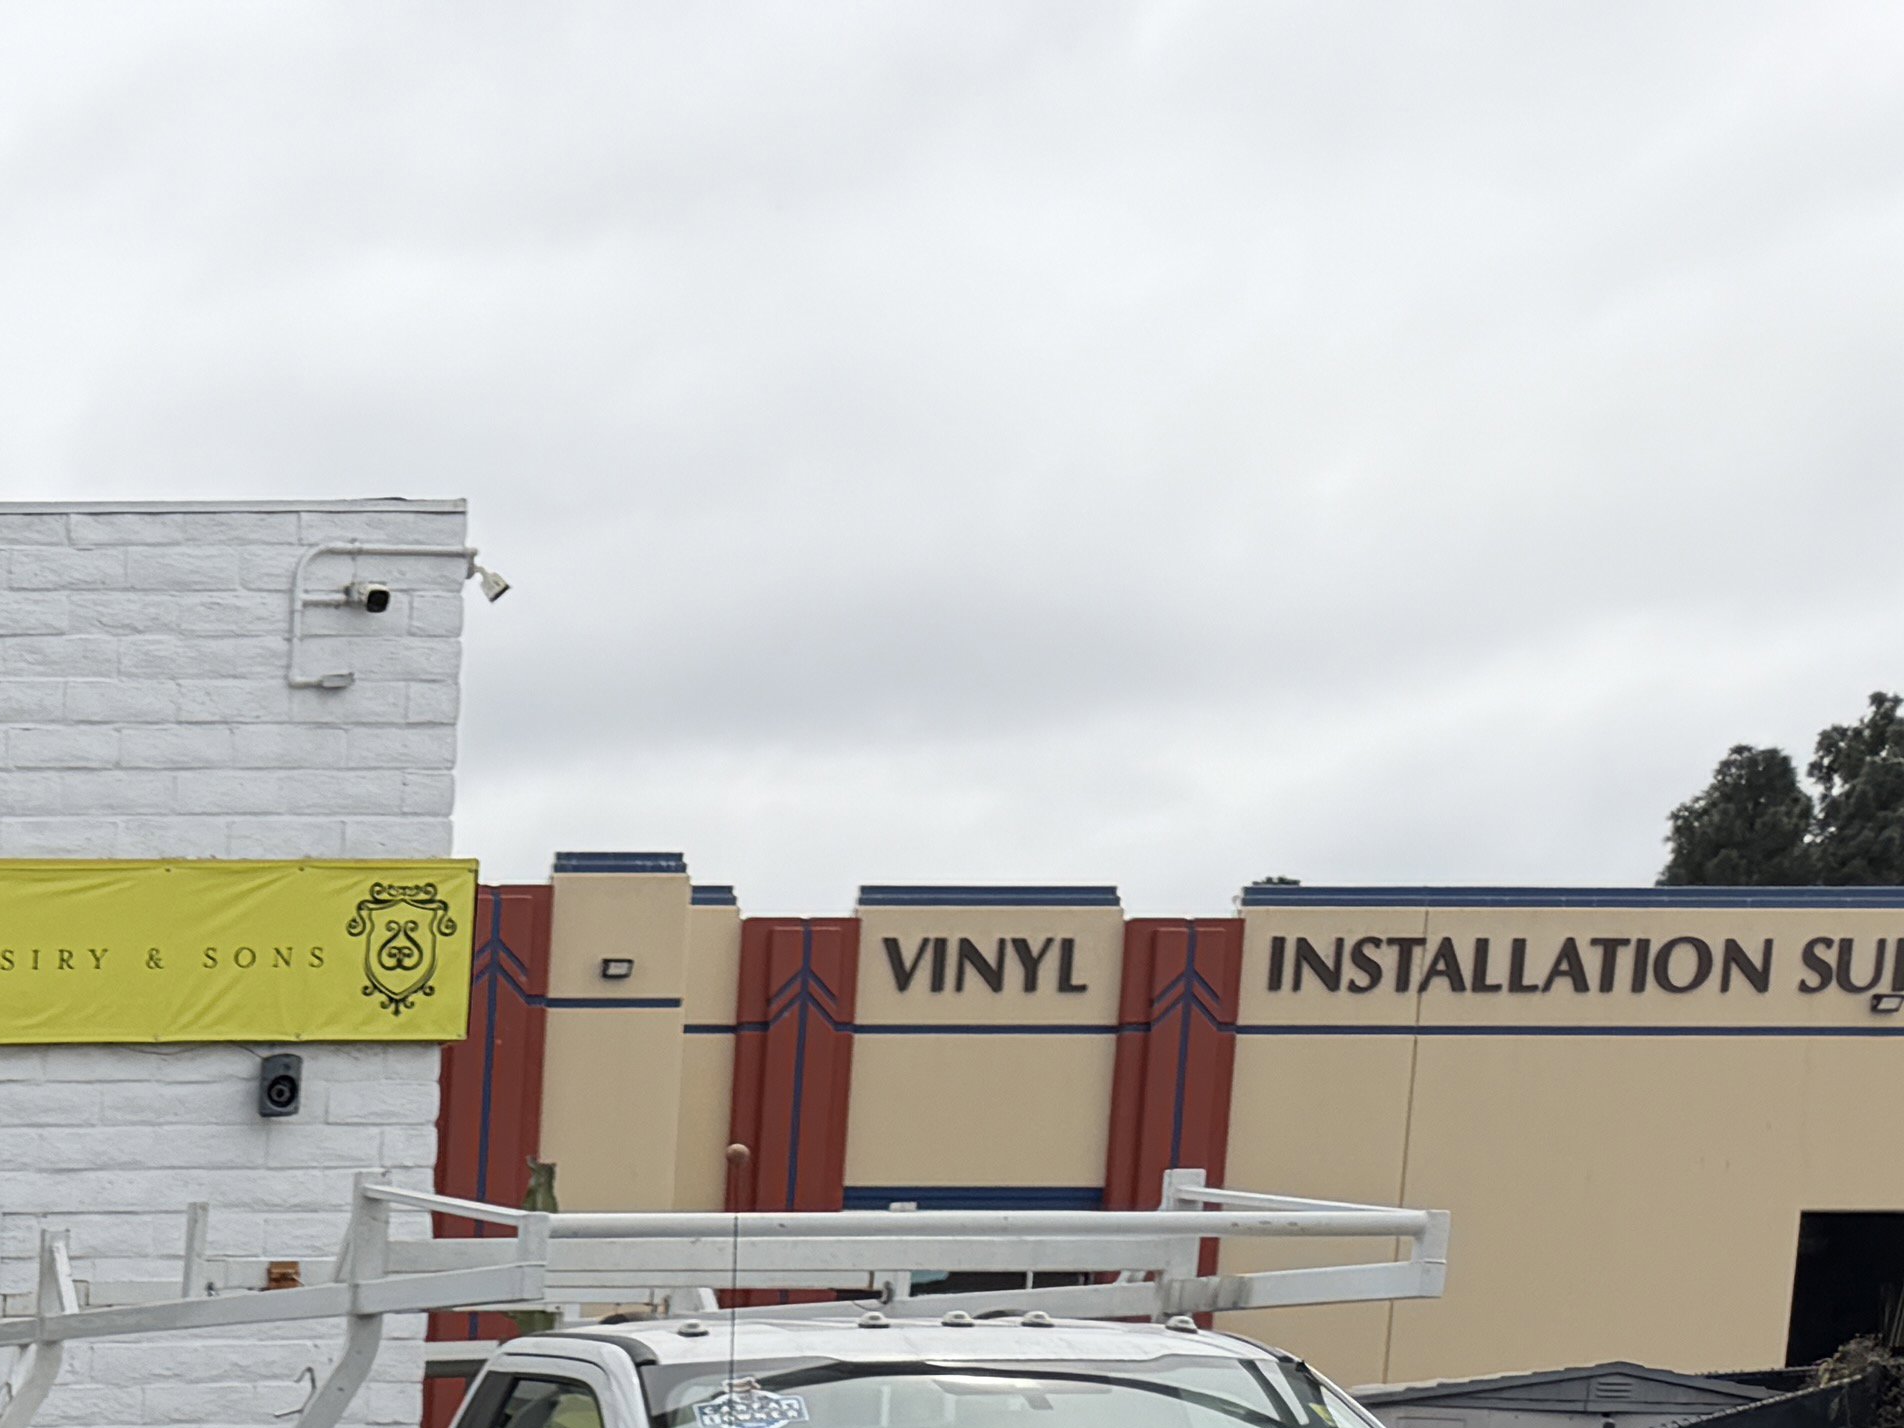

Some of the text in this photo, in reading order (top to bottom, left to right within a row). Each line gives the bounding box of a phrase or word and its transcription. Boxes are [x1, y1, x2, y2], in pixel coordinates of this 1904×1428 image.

[0, 946, 326, 971] SIRY & SONS
[882, 935, 1089, 996] VINYL
[1267, 935, 1774, 995] INSTALLATION
